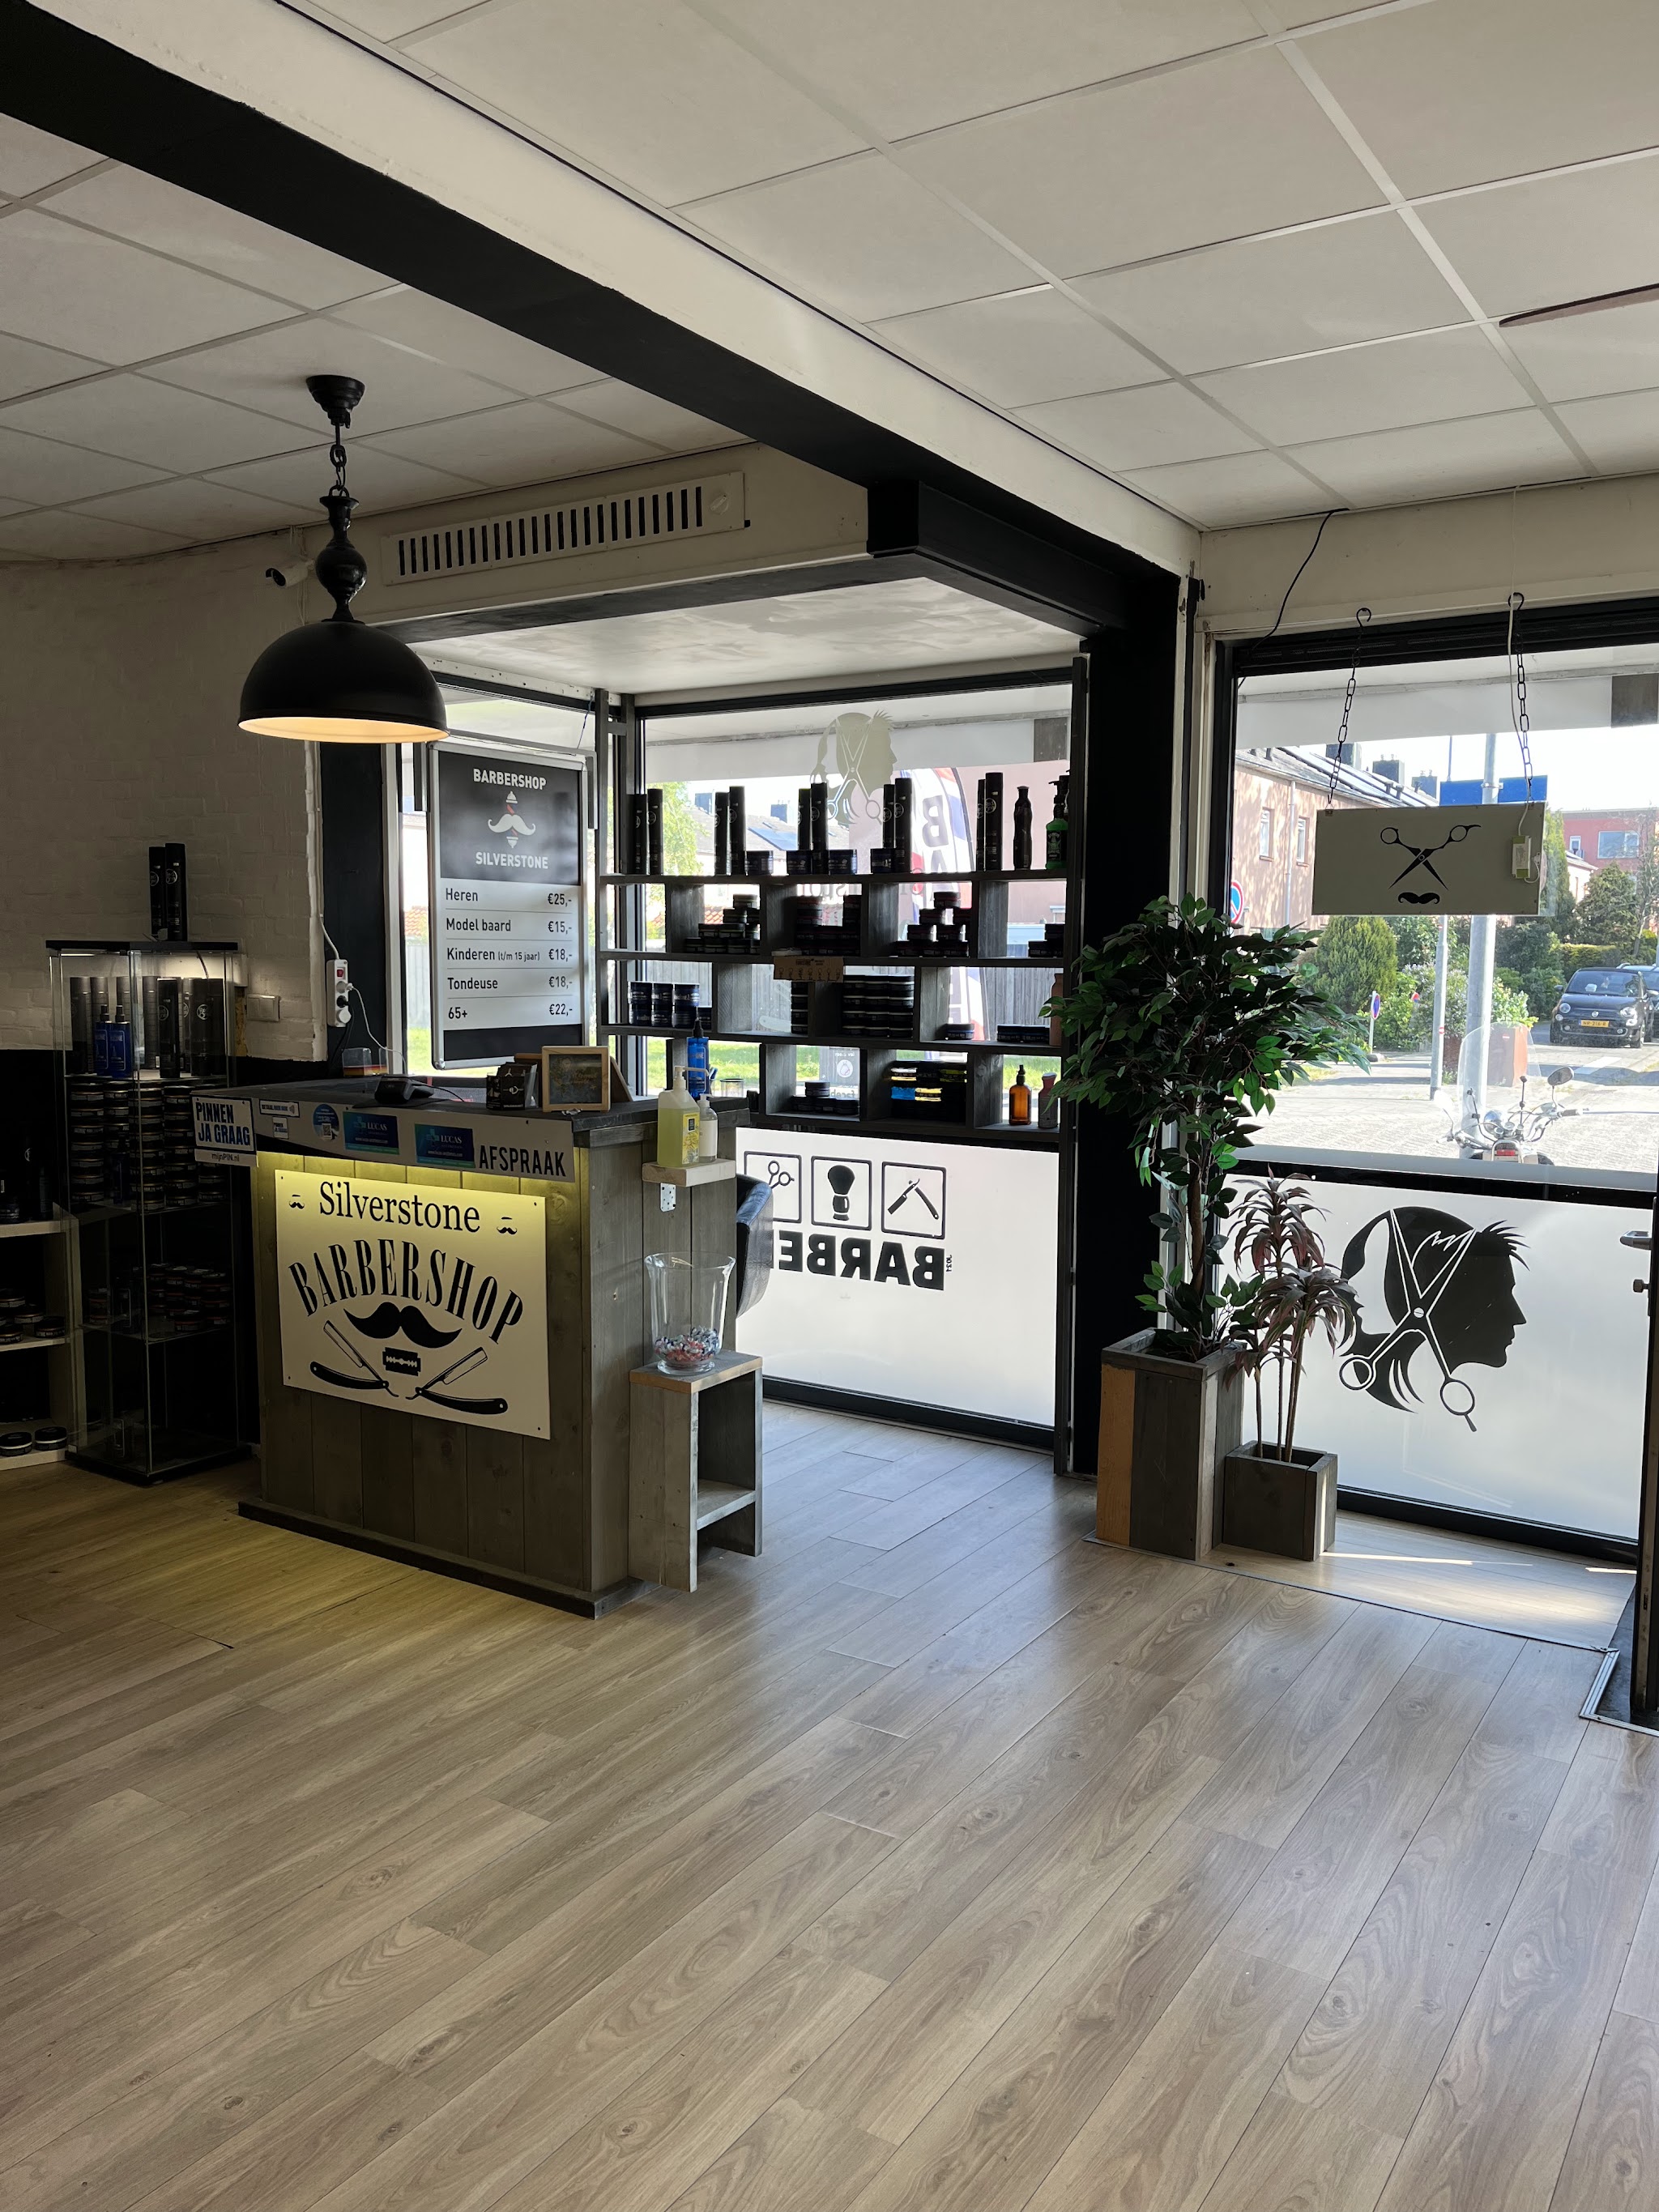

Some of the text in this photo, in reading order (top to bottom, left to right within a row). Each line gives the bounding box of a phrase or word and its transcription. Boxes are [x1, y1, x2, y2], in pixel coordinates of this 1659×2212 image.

[473, 768, 547, 791] BARBERSHOP
[476, 851, 548, 870] SILVERSTONE
[446, 888, 572, 907] Heren €25,-
[446, 918, 572, 935] Model baard €15,-
[447, 948, 573, 963] Kinderen (t/m 15 jaar) €18,-
[447, 976, 573, 990] Tondeuse €18,-
[448, 1004, 573, 1020] 65+ €22,-
[195, 1102, 234, 1123] PINNEN
[198, 1123, 211, 1142] JA
[214, 1124, 250, 1145] GRAAG
[367, 1122, 387, 1131] LUCAS
[441, 1135, 462, 1144] LUCAS
[479, 1144, 567, 1177] AFSPRAAK
[319, 1181, 480, 1233] Silverstone
[288, 1238, 523, 1345] BARBERSHOP
